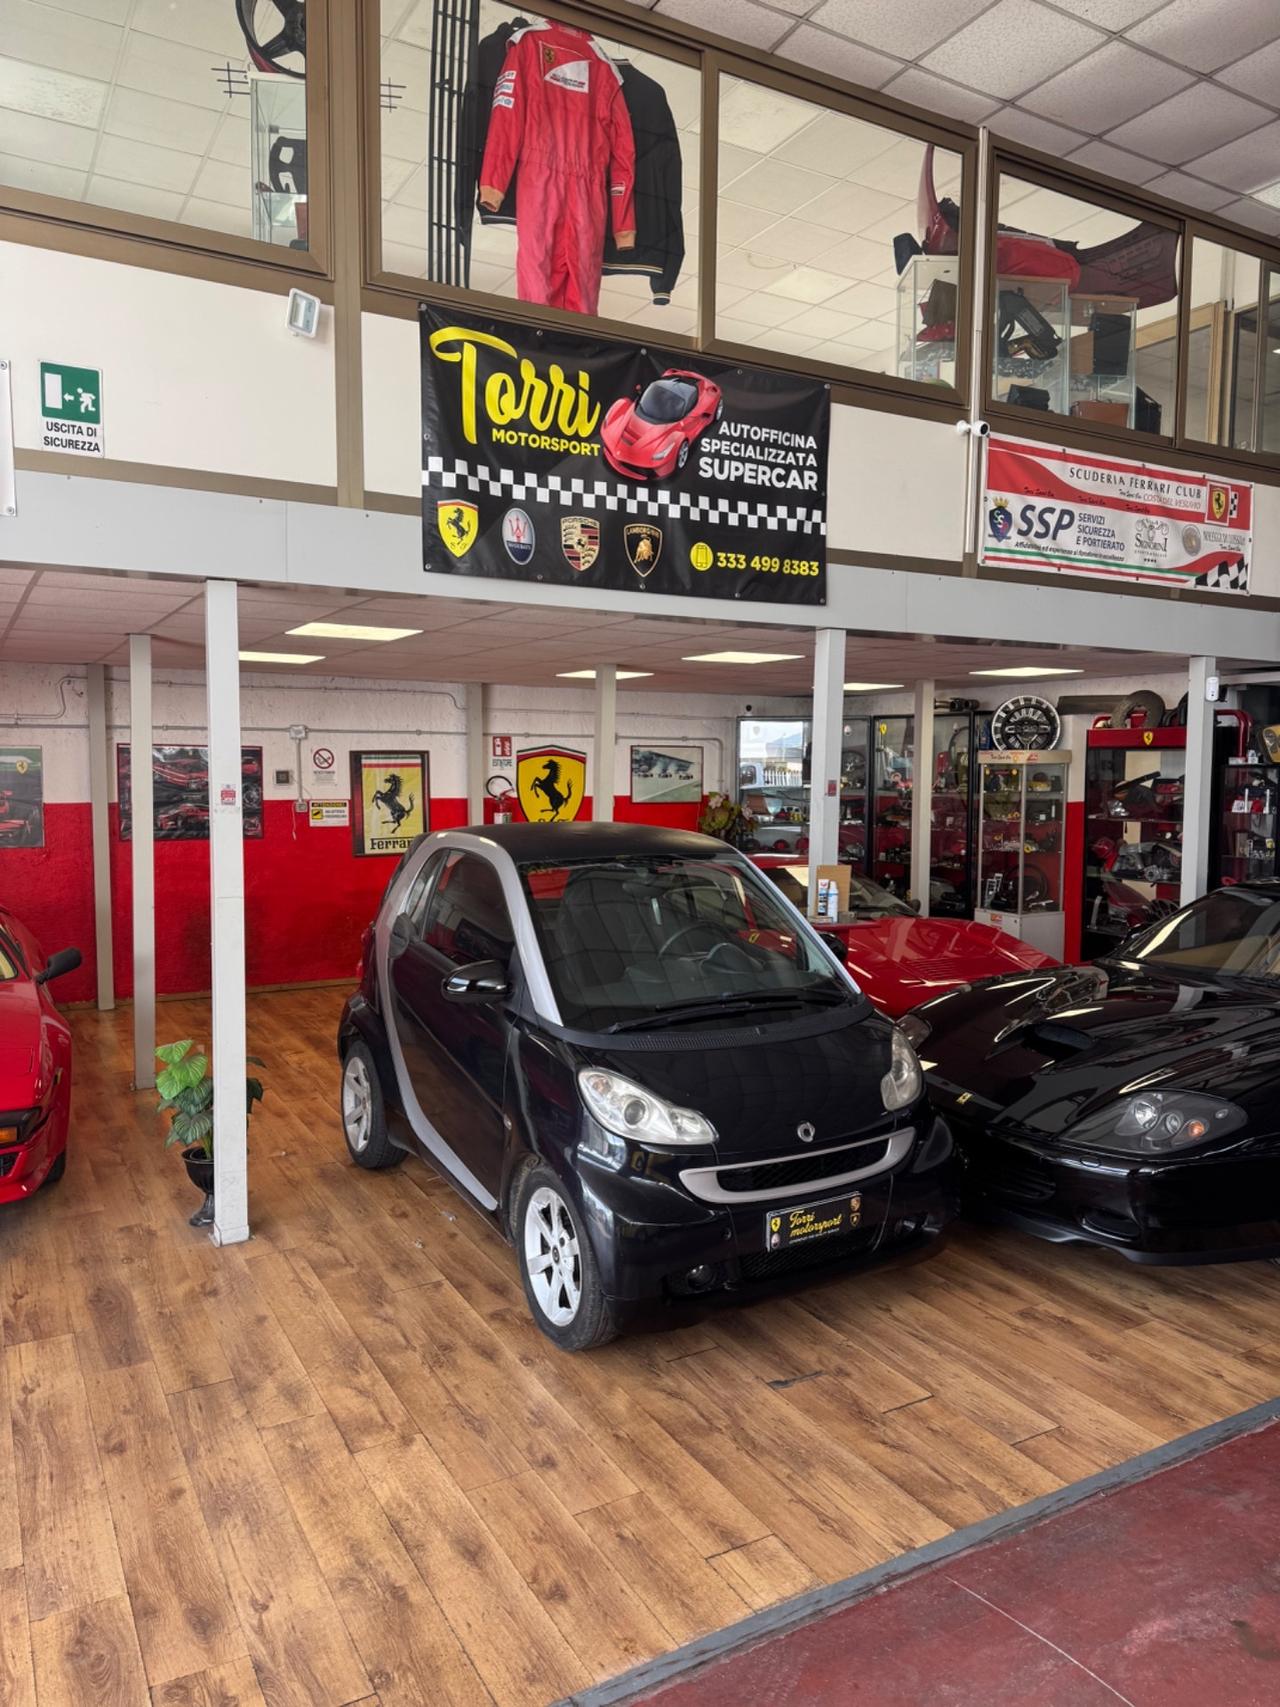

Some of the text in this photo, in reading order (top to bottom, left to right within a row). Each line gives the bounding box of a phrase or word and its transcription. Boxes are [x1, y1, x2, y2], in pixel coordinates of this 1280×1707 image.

[430, 326, 600, 444] Torri
[46, 421, 96, 437] USCITA DI
[492, 428, 600, 456] MOTORSPORT
[718, 421, 818, 449] AUTOFFICINA
[44, 436, 100, 452] SICUREZZA
[700, 438, 818, 467] SPECIALIZZATA
[698, 456, 818, 491] SUPERCAR
[1069, 467, 1125, 486] SCUDERIA
[1129, 476, 1171, 494] FERRARI
[1176, 486, 1202, 498] CLUB
[1016, 504, 1075, 541] SSP
[1077, 524, 1116, 538] SICUREZZA
[1078, 512, 1106, 525] SERVIZI
[1076, 536, 1126, 552] E PORTIERATO
[716, 552, 820, 576] 333 499 8383
[370, 837, 412, 850] Ferrar
